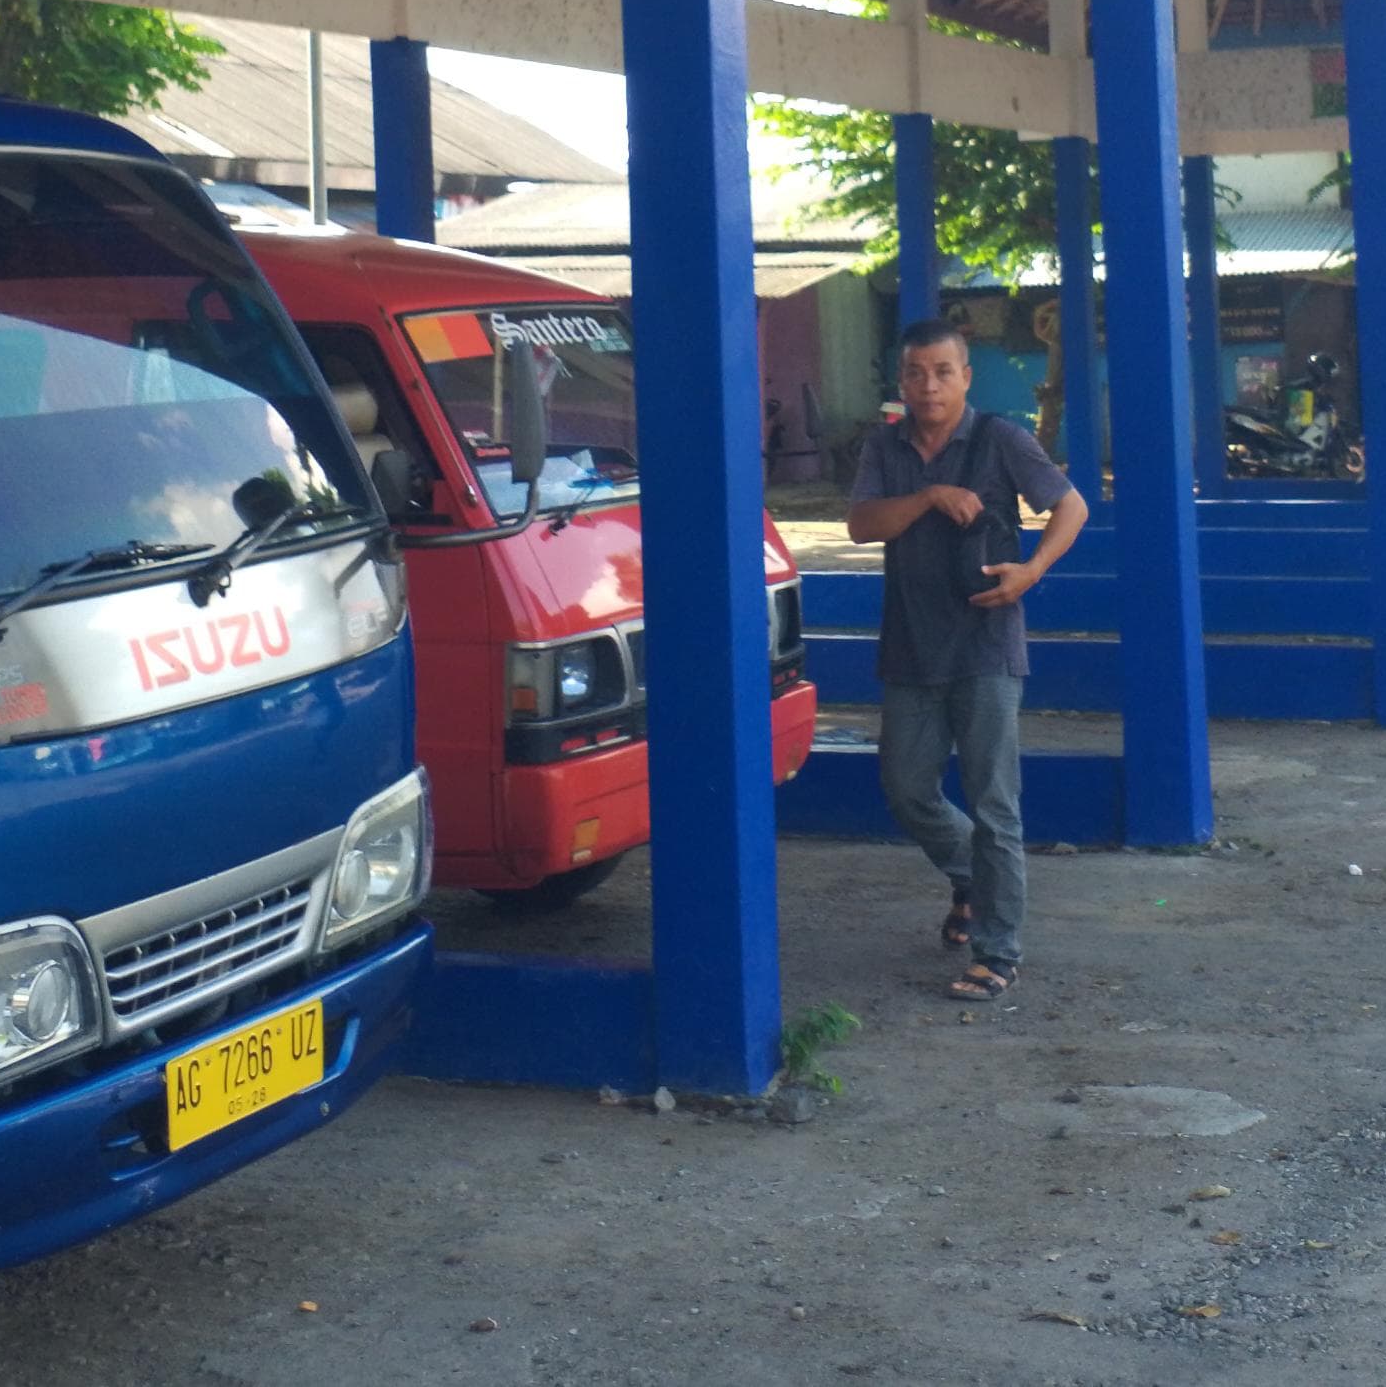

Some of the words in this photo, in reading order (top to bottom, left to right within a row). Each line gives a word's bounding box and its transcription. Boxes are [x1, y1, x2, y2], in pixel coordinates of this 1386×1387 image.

[129, 605, 291, 692] ISUZU
[176, 1059, 202, 1116] AG
[219, 1028, 273, 1094] 7266
[291, 1008, 318, 1061] UZ
